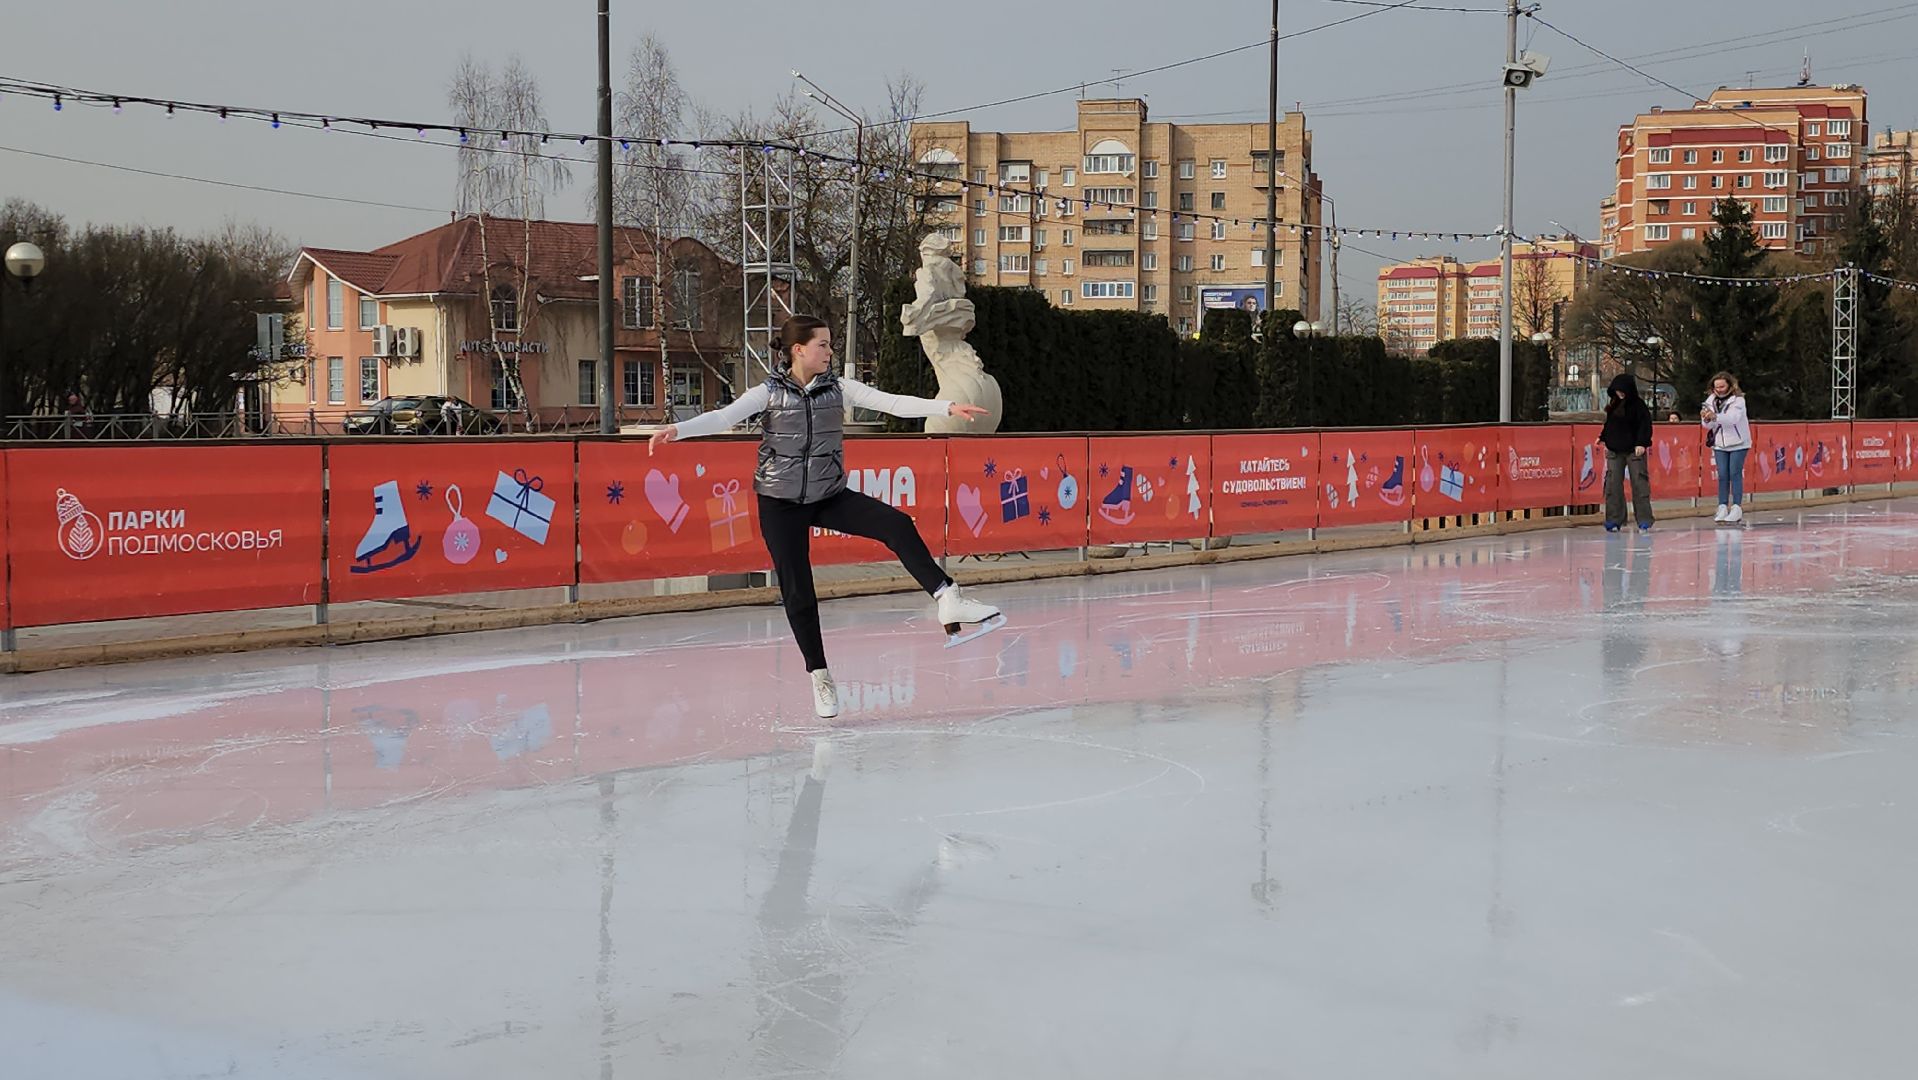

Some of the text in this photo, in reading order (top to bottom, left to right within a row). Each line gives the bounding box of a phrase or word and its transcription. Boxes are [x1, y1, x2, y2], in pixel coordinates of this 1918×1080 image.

[1240, 457, 1290, 473] КАТАЙТЕСЬ
[108, 510, 185, 530] ПАРКИ
[108, 529, 283, 555] ПОДМОСКОВЬЯ
